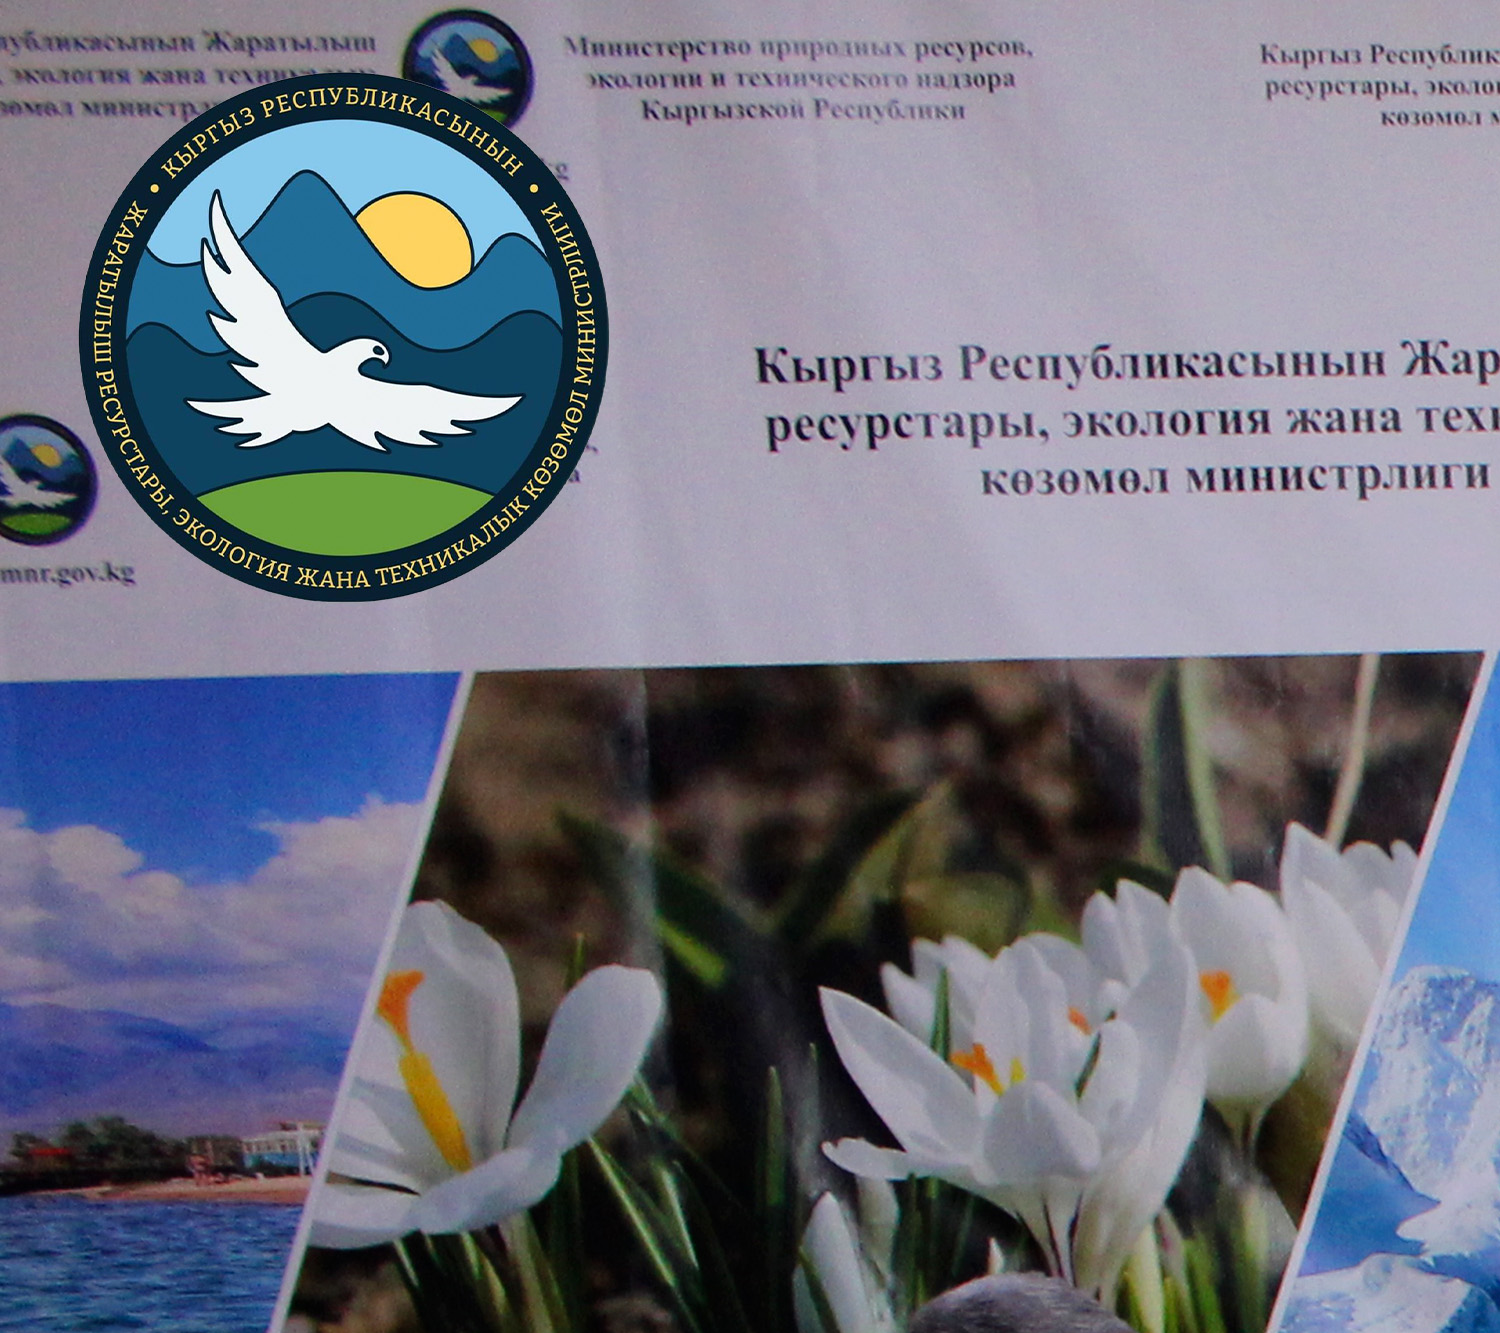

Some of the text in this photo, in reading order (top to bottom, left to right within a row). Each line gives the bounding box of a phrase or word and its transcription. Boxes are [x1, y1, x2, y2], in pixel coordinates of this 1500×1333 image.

[202, 30, 376, 58] Жаратылыш
[564, 36, 1034, 63] Министерство природных ресурсов,
[1260, 44, 1362, 71] Кыргыз
[587, 72, 1016, 94] экологии и технического надзора
[1265, 79, 1418, 102] ресурстары,
[641, 98, 965, 126] Кыргызской Республики
[753, 345, 944, 393] Кыргыз
[958, 343, 1387, 391] Республикасынын
[764, 407, 1050, 454] ресурстары,
[1062, 408, 1272, 439] экология
[1286, 406, 1403, 435] жана
[980, 462, 1491, 502] көзөмөл министрлиги
